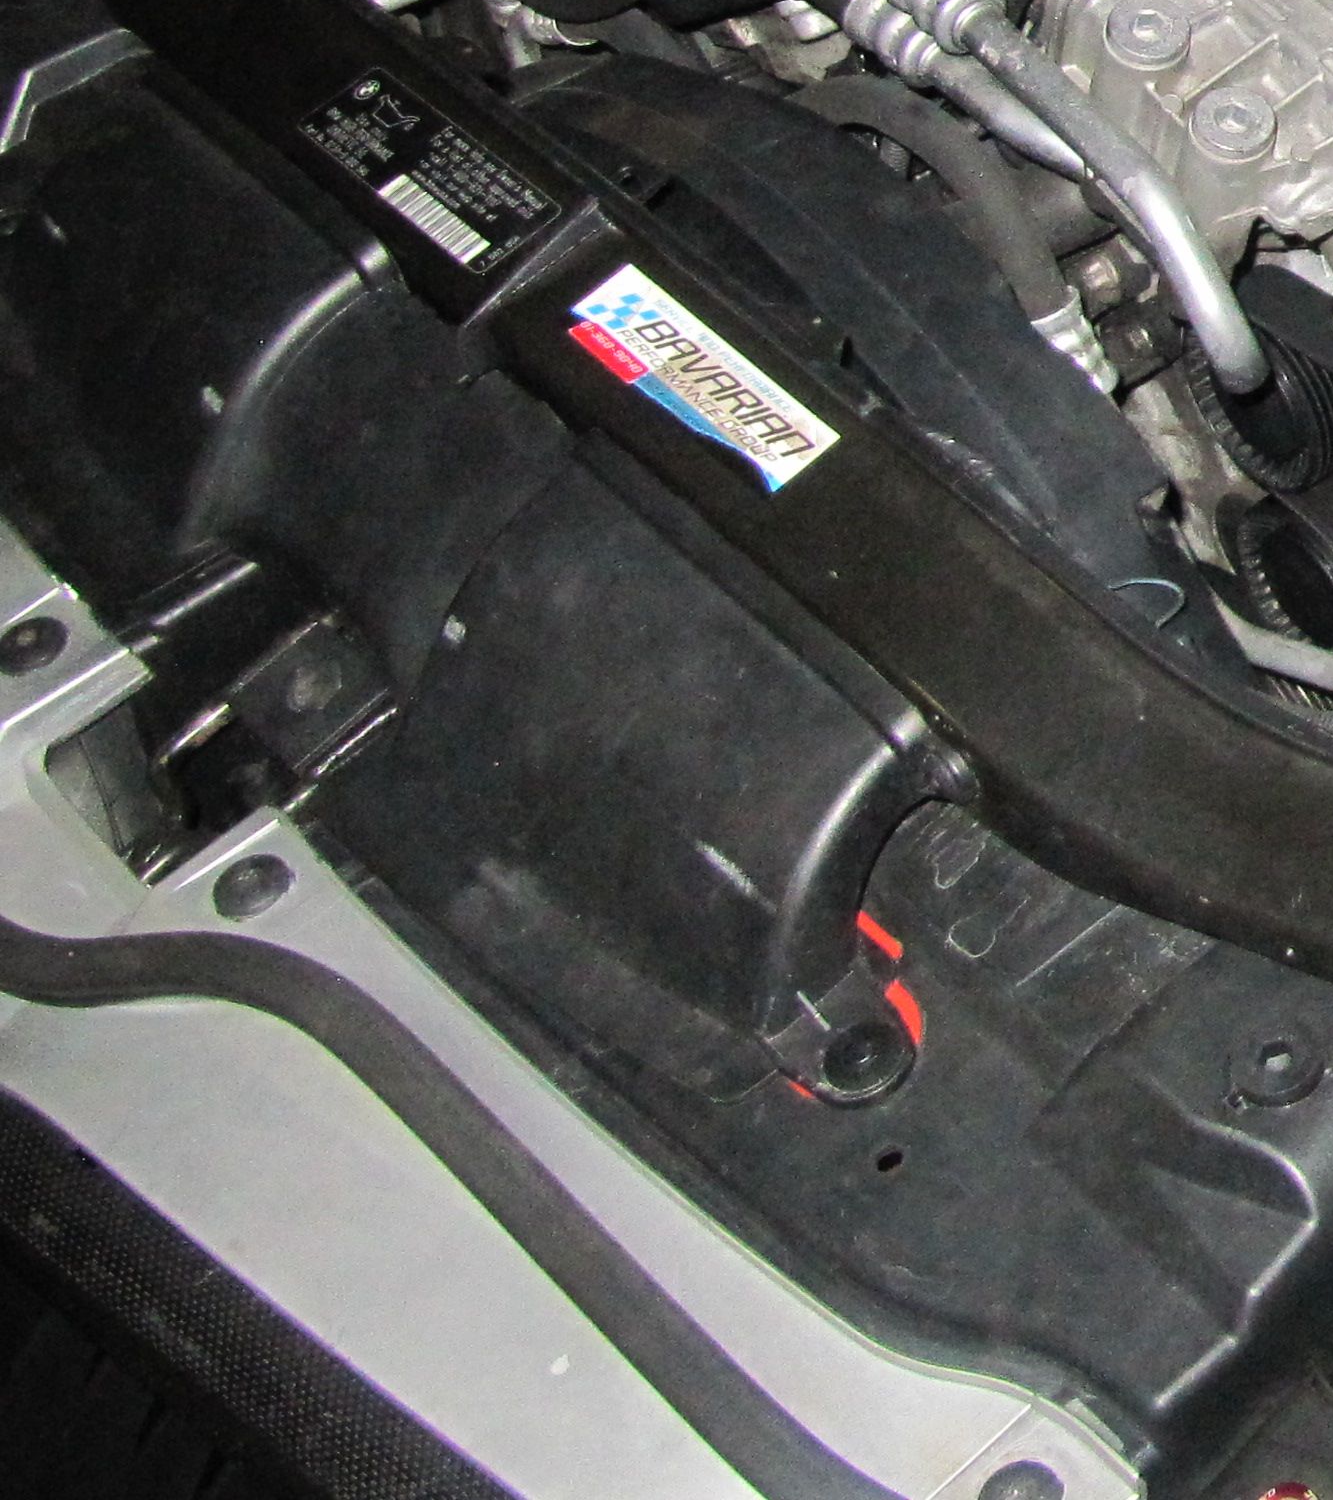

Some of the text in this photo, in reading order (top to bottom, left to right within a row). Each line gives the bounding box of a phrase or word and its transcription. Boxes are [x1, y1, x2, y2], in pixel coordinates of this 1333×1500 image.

[617, 329, 778, 463] PERFORMANCE GROUP
[635, 319, 815, 459] BAVARIAN
